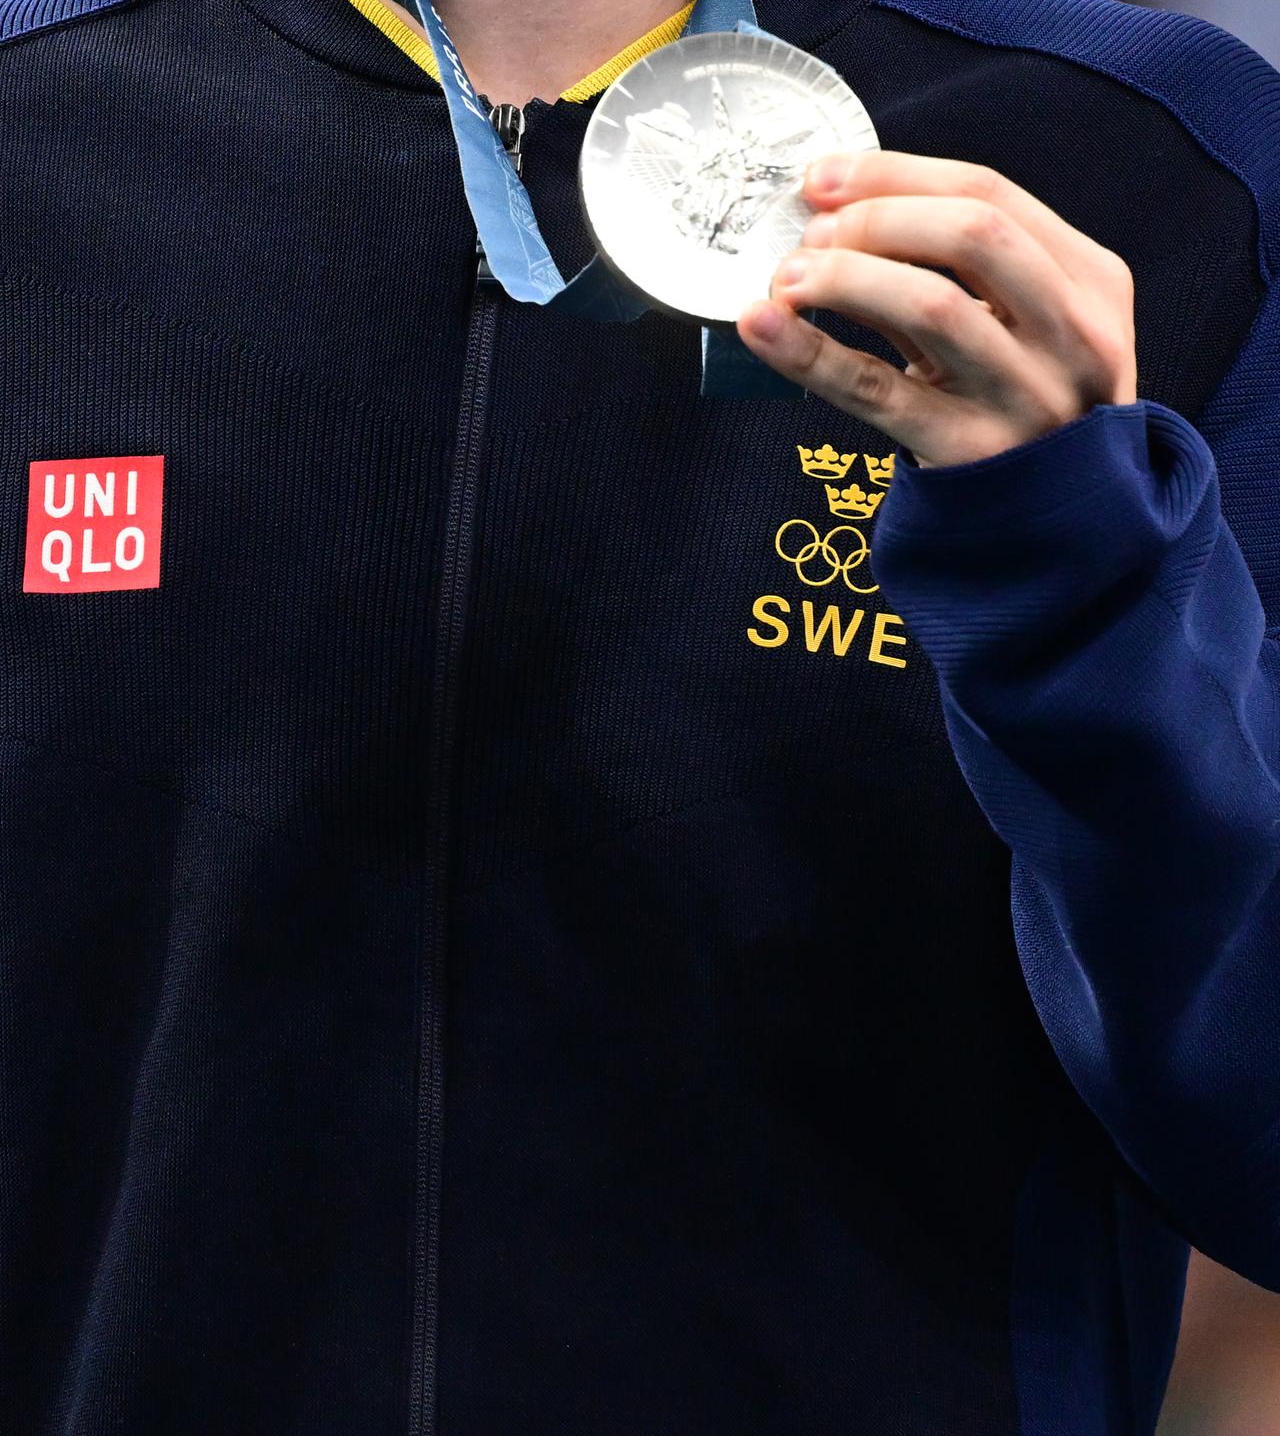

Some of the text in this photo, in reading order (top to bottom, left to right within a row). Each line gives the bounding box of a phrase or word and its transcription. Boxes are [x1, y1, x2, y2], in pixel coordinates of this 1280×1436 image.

[44, 470, 138, 519] UNI
[41, 526, 145, 582] QLO
[747, 594, 907, 669] SWE
